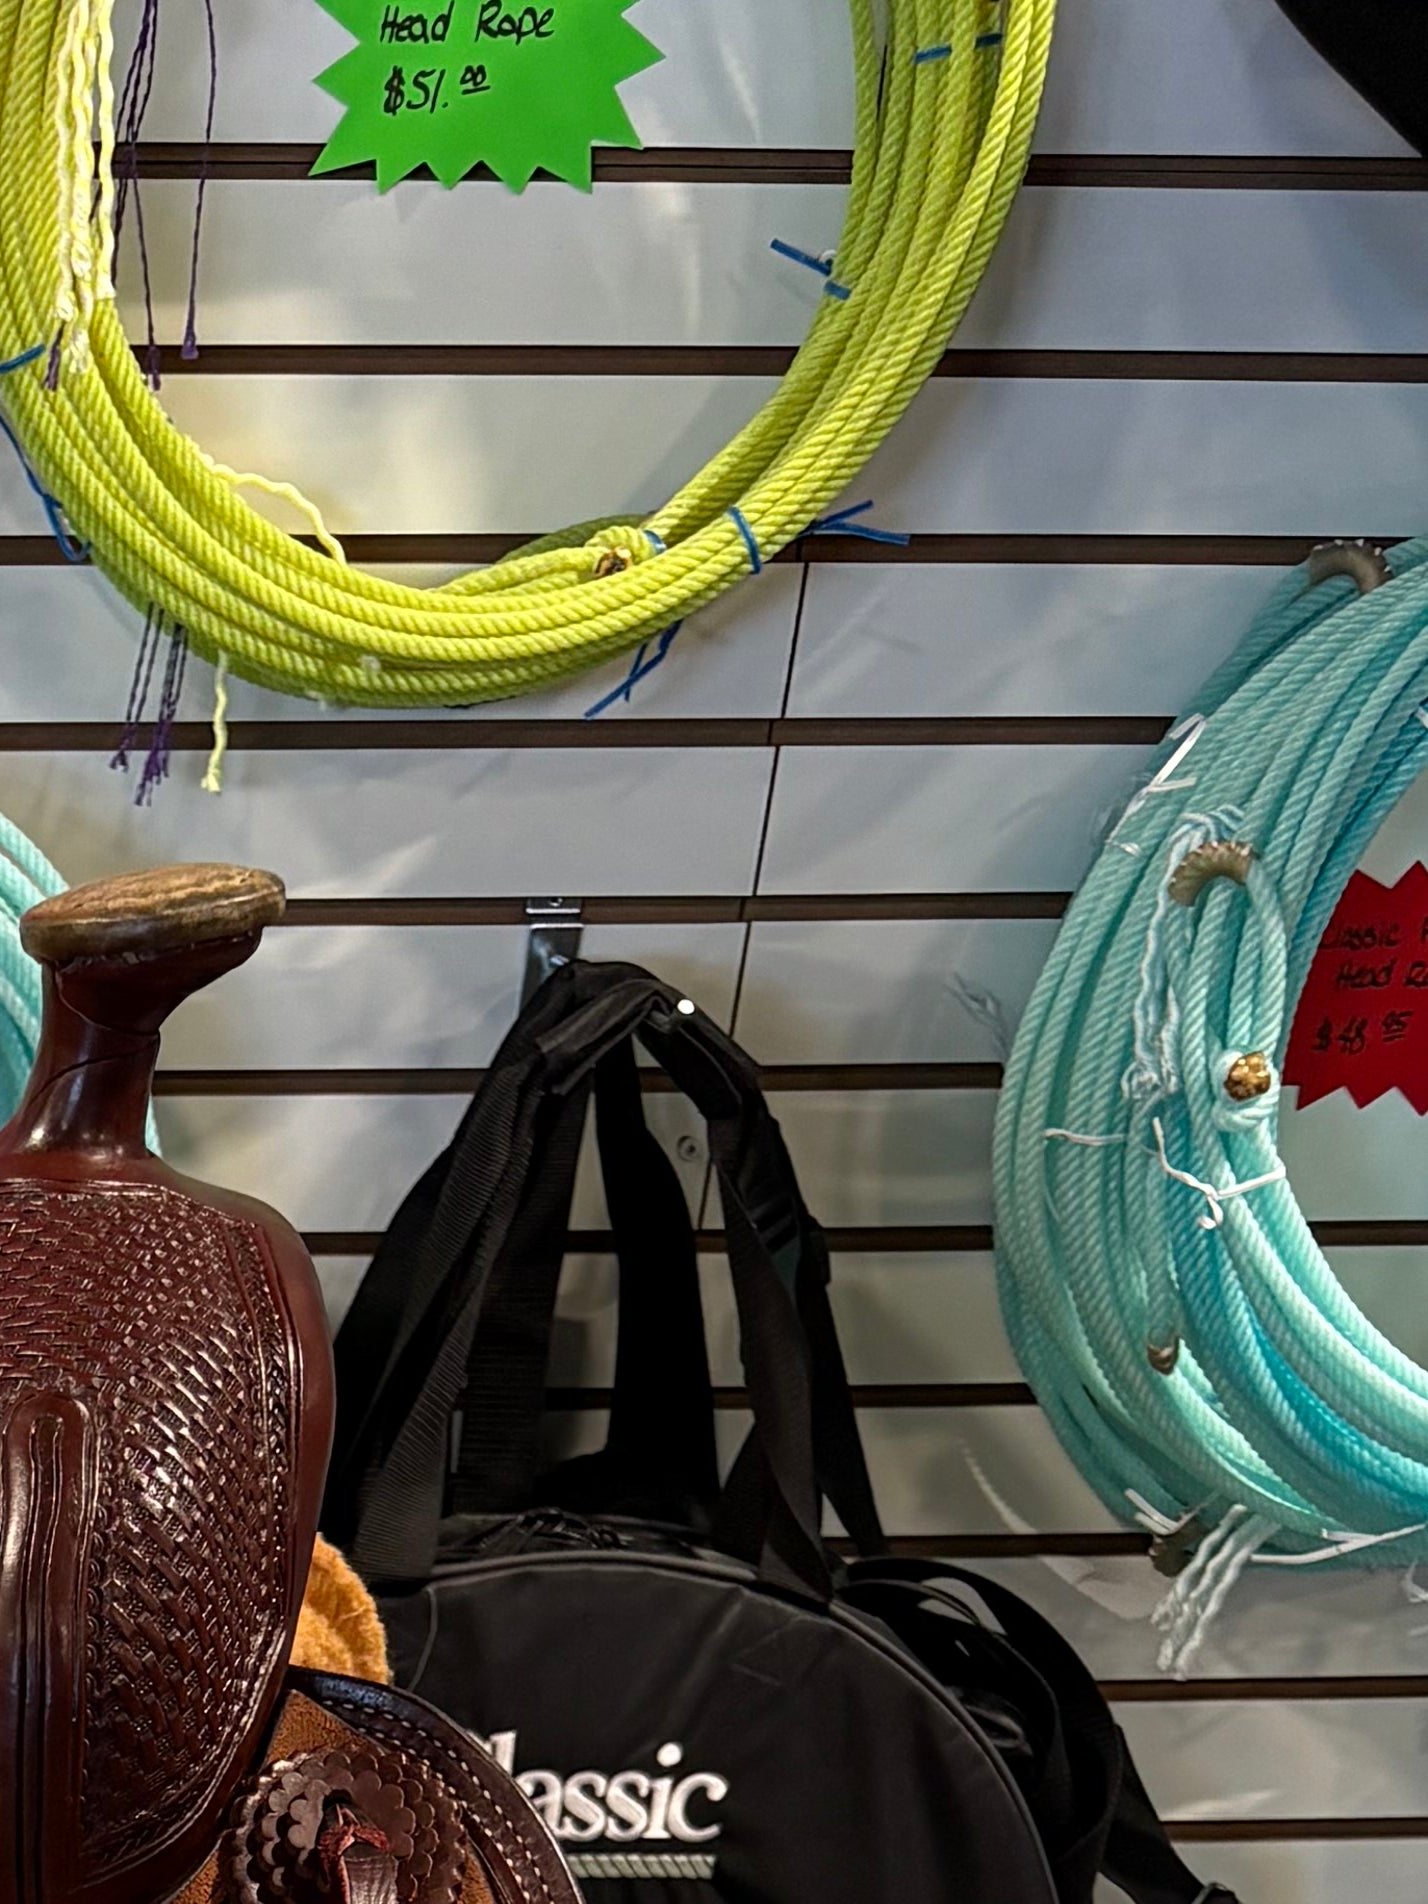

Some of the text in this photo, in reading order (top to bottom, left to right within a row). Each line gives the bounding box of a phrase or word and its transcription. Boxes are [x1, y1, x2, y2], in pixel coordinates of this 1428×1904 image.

[379, 0, 555, 45] Head Rope
[466, 1730, 729, 1843] assic
